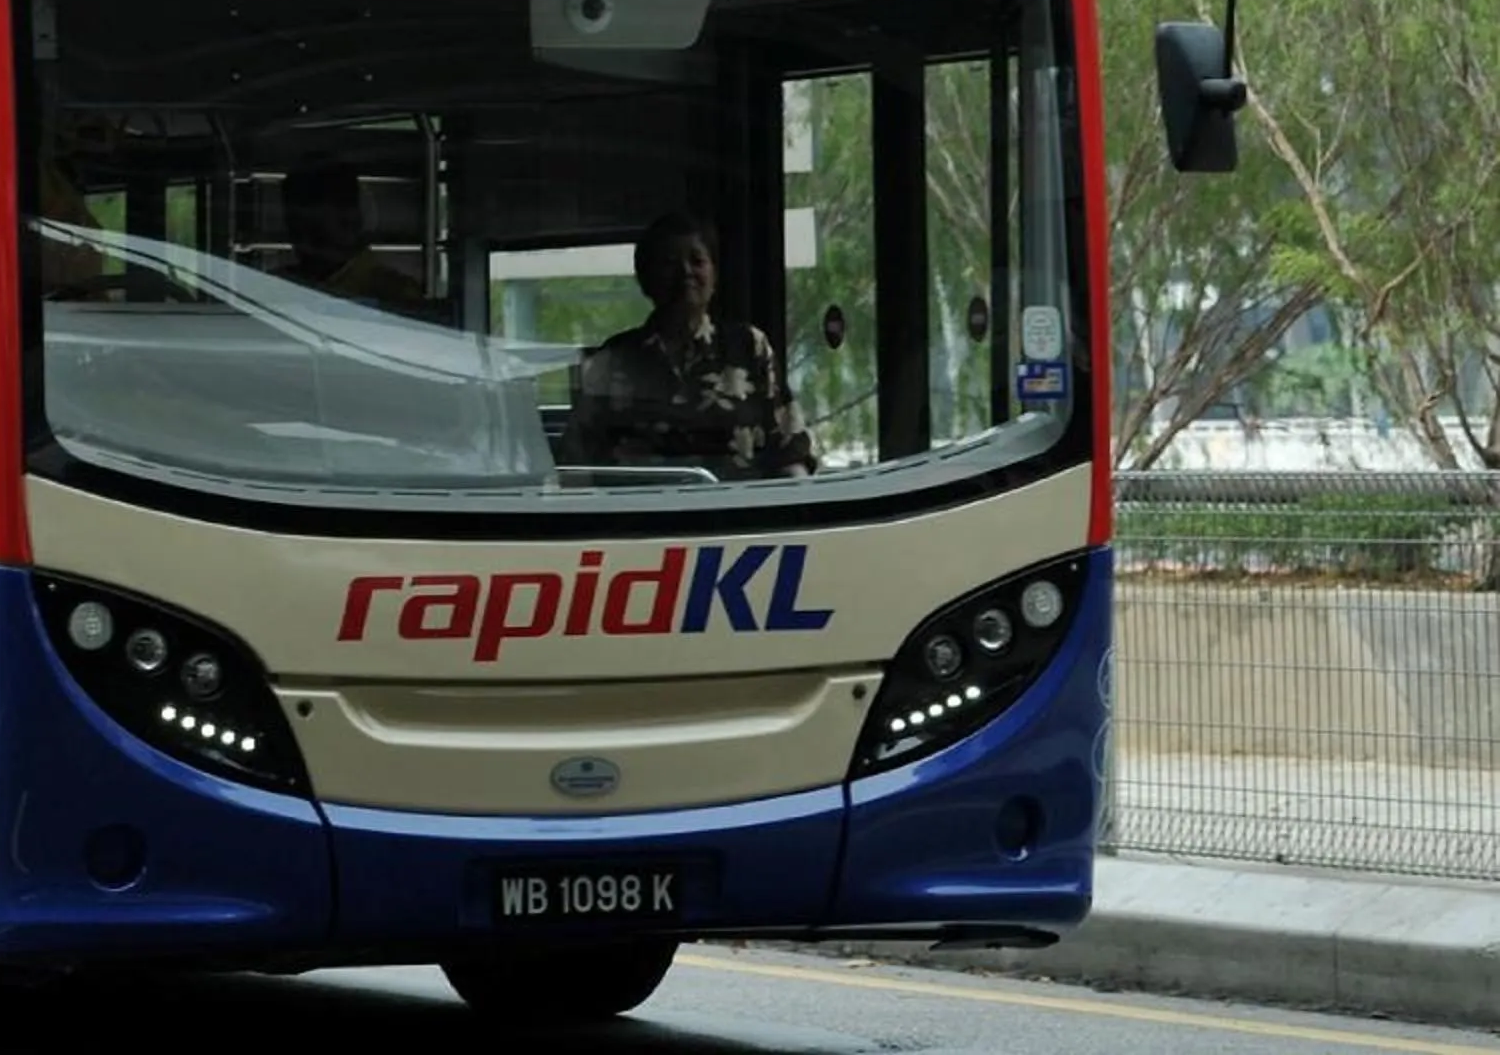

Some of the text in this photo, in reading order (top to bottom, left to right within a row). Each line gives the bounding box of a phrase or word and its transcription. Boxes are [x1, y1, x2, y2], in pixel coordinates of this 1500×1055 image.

[336, 544, 836, 662] rapidKL
[501, 873, 674, 916] WB 1098 K
